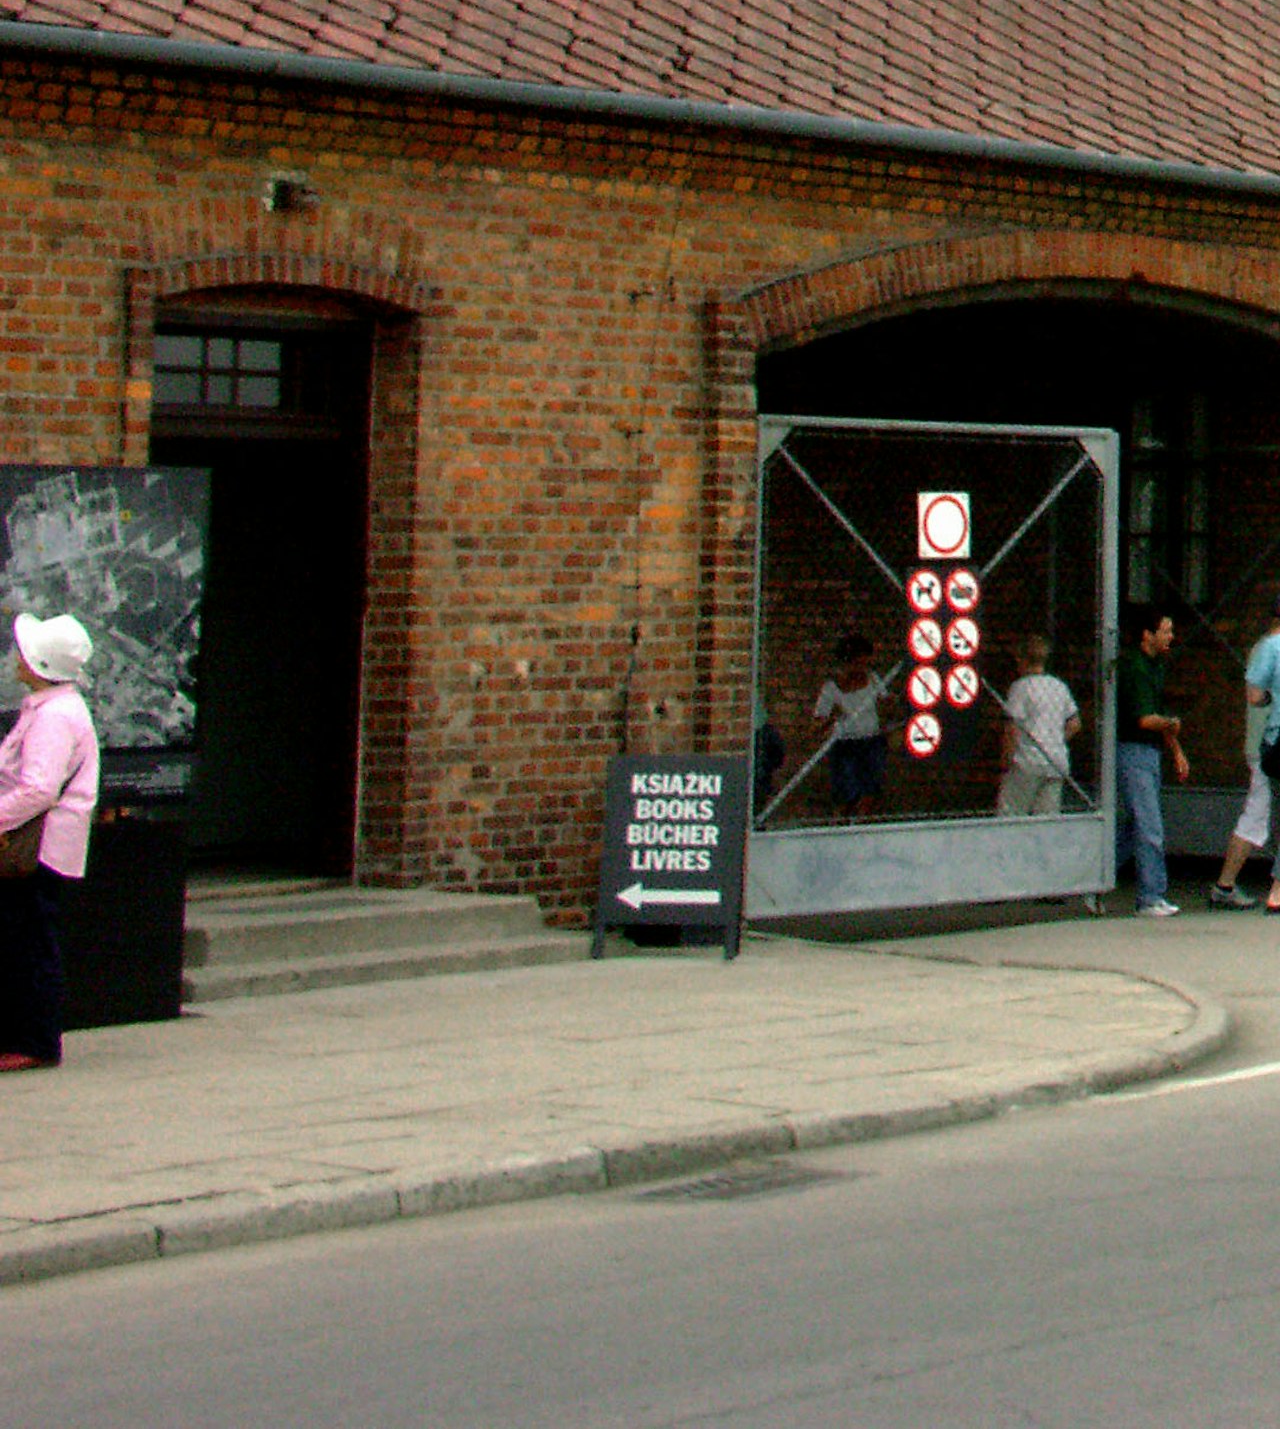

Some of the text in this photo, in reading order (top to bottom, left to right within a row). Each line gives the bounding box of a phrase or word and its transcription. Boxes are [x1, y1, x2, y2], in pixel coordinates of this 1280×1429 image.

[635, 799, 714, 820] BOOKS
[627, 822, 719, 845] BÜCHER
[630, 849, 711, 871] LIVRES
